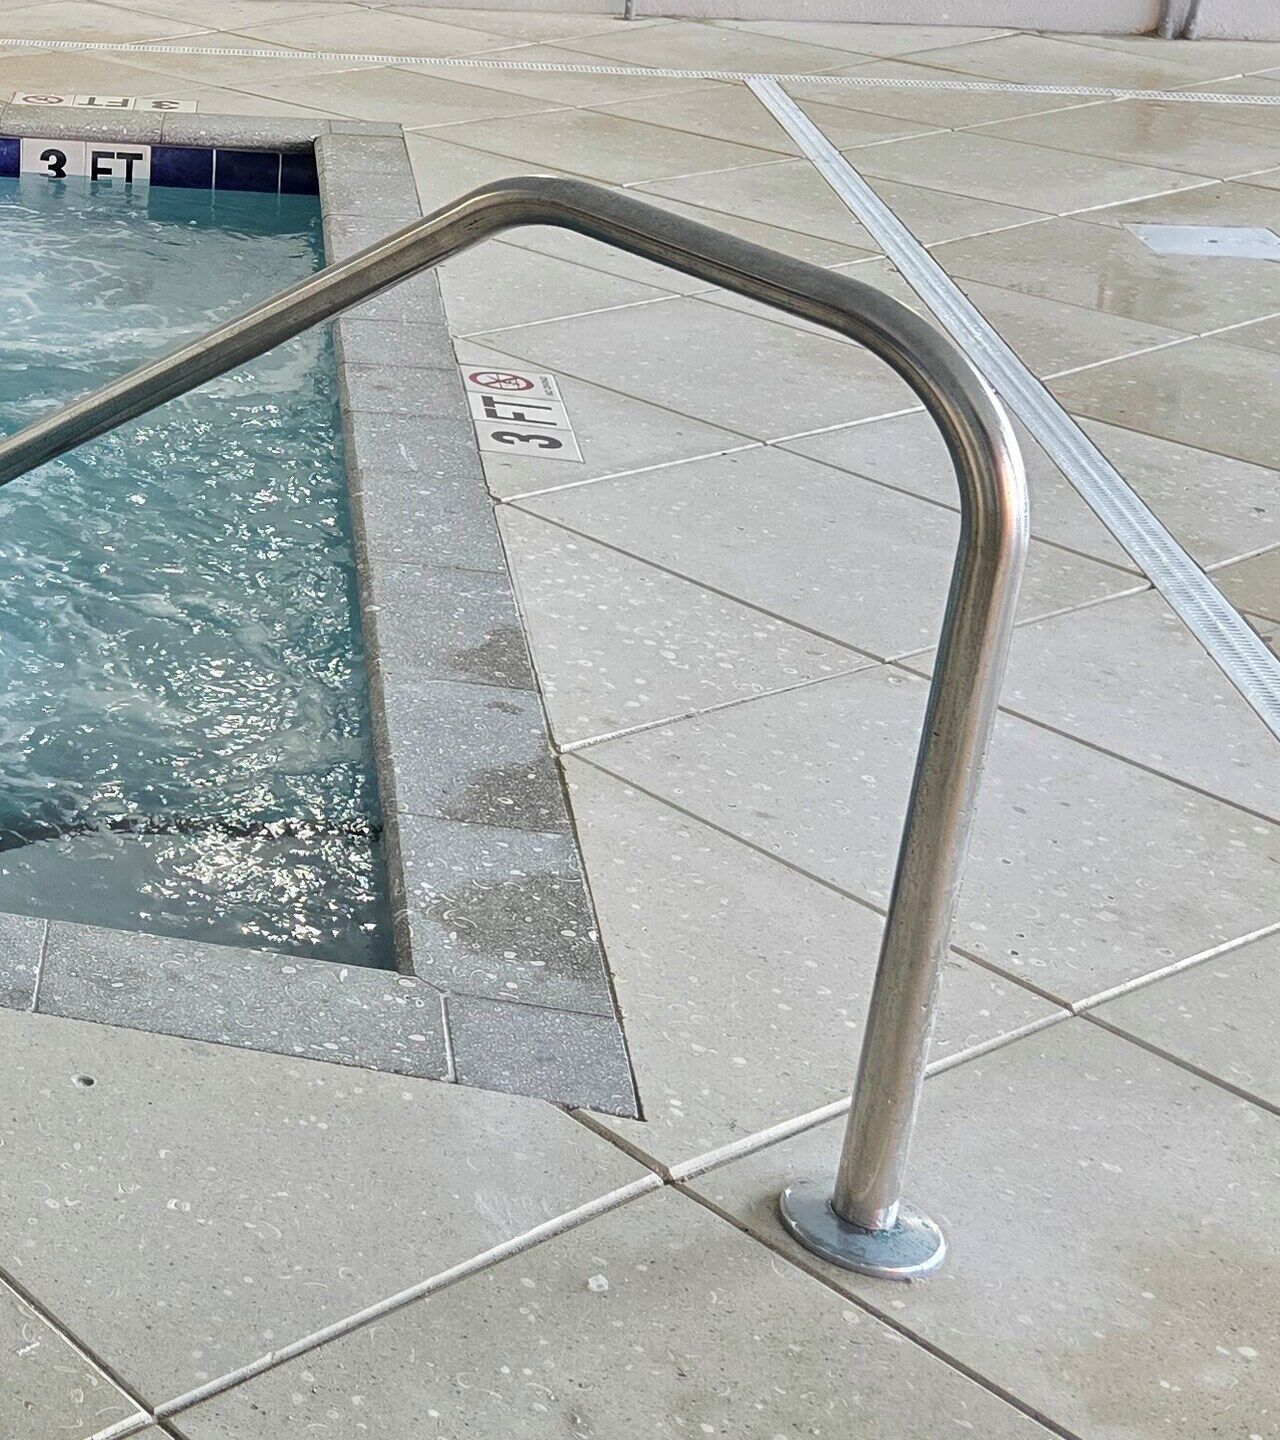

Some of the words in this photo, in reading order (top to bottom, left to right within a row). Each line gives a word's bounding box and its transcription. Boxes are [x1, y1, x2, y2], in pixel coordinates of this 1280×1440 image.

[78, 96, 130, 108] FT
[151, 100, 180, 110] 3
[39, 148, 68, 179] 3
[90, 150, 143, 184] FT
[481, 395, 558, 426] FT
[491, 430, 563, 450] 3
